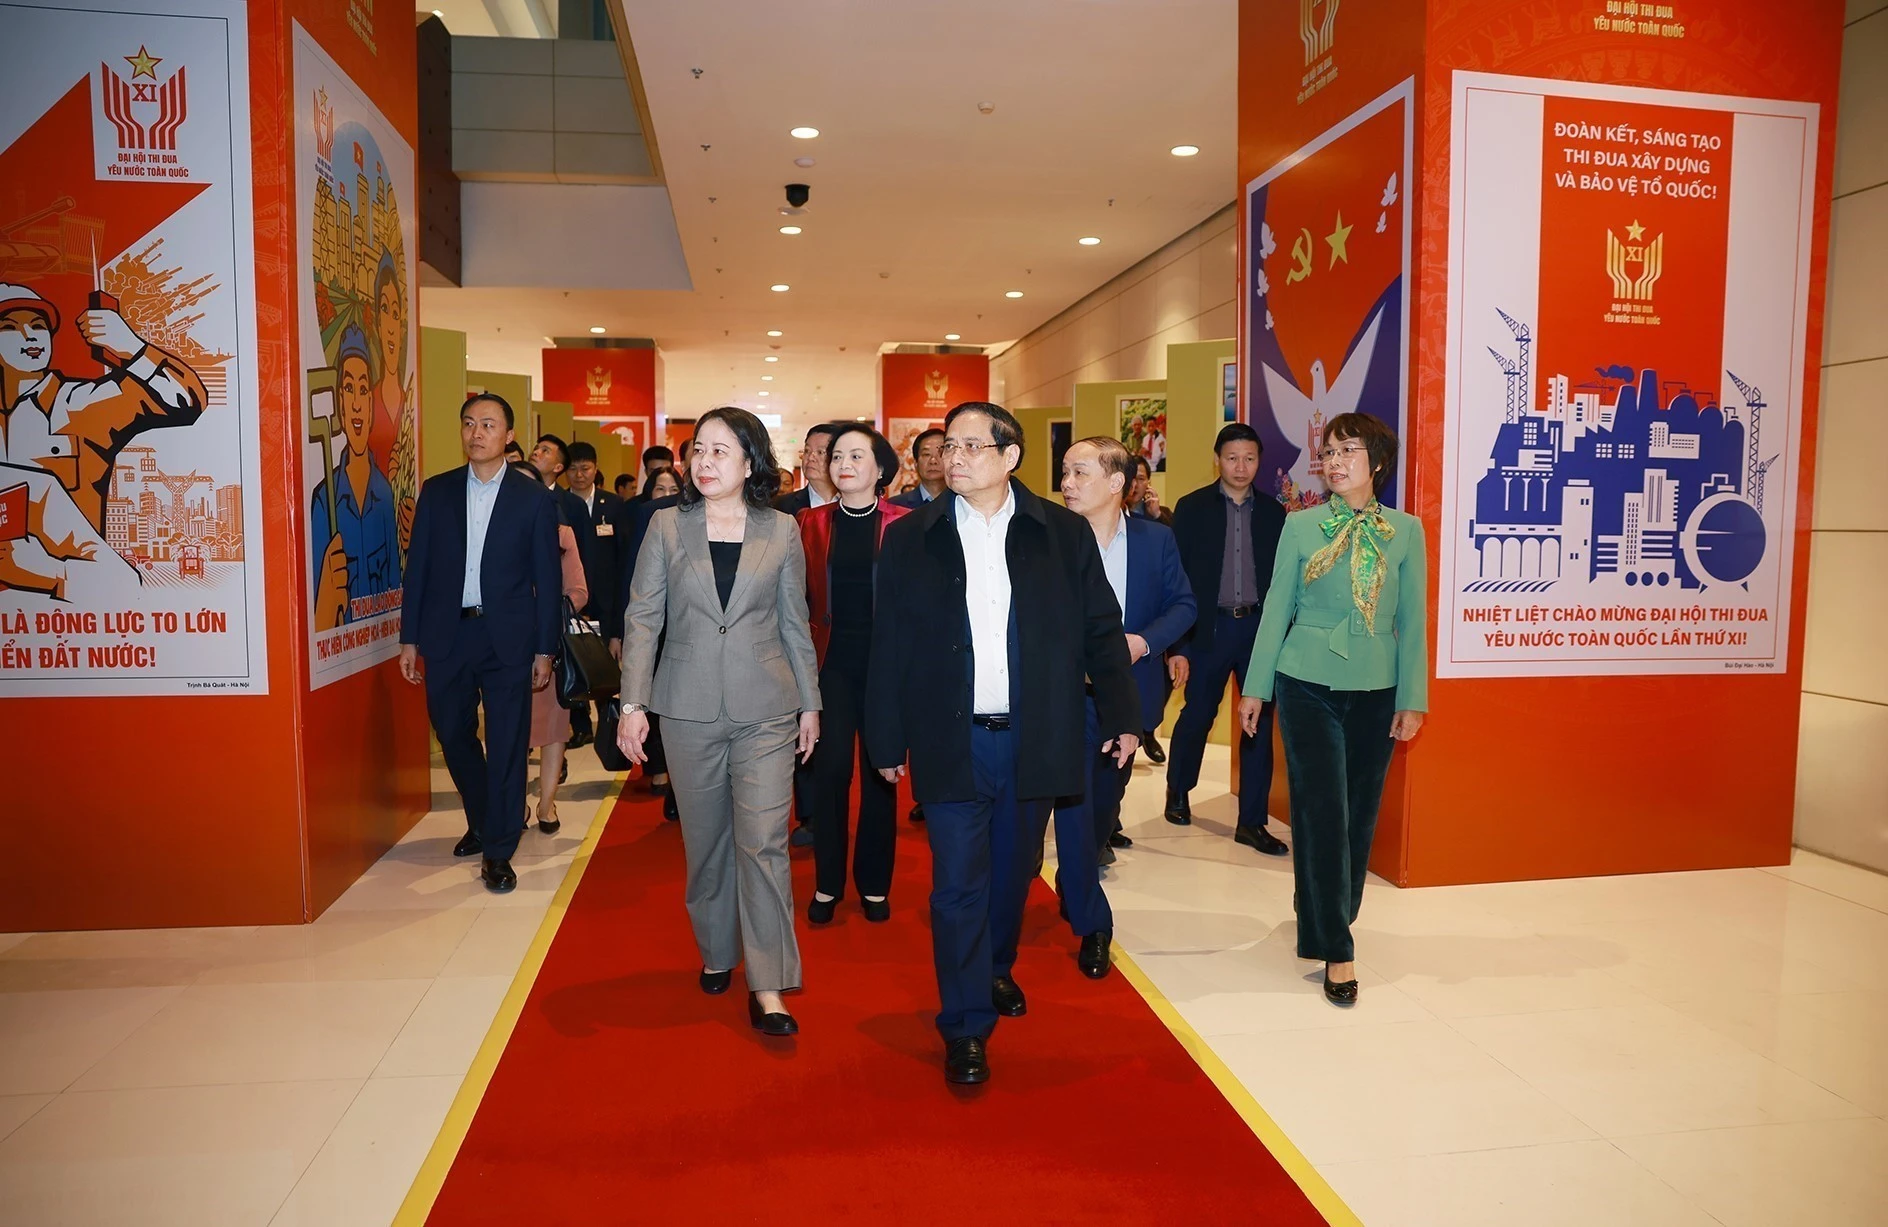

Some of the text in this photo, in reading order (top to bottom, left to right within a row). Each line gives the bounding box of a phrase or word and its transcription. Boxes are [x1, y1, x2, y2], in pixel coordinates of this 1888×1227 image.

[1607, 0, 1673, 19] ĐẠI HỘI THI ĐUA
[1594, 15, 1685, 38] YÊU NƯỚC TOÀN QUỐC
[132, 84, 158, 102] XI
[1554, 121, 1721, 152] ĐOÀN KẾT, SÁNG TẠO
[118, 152, 177, 164] ĐẠI HỘI THI ĐUA
[1563, 148, 1711, 175] THI ĐUA XÂY DỰNG
[108, 164, 189, 177] YÊU NƯỚC TOÀN QUỐC
[1555, 171, 1717, 199] VÀ BẢO VỆ TỔ QUỐC!
[1626, 246, 1643, 262] XI
[2, 608, 226, 638] LÀ ĐỘNG LỰC TO LỚN
[1463, 605, 1768, 626] NHIỆT LIỆT CHÀO MỪNG ĐẠI HỘI THI ĐUA
[1484, 628, 1747, 647] YÊU NƯỚC TOÀN QUỐC LẦN THỨ XI!
[39, 640, 81, 668] ĐẤT
[88, 643, 156, 668] NƯỚC!
